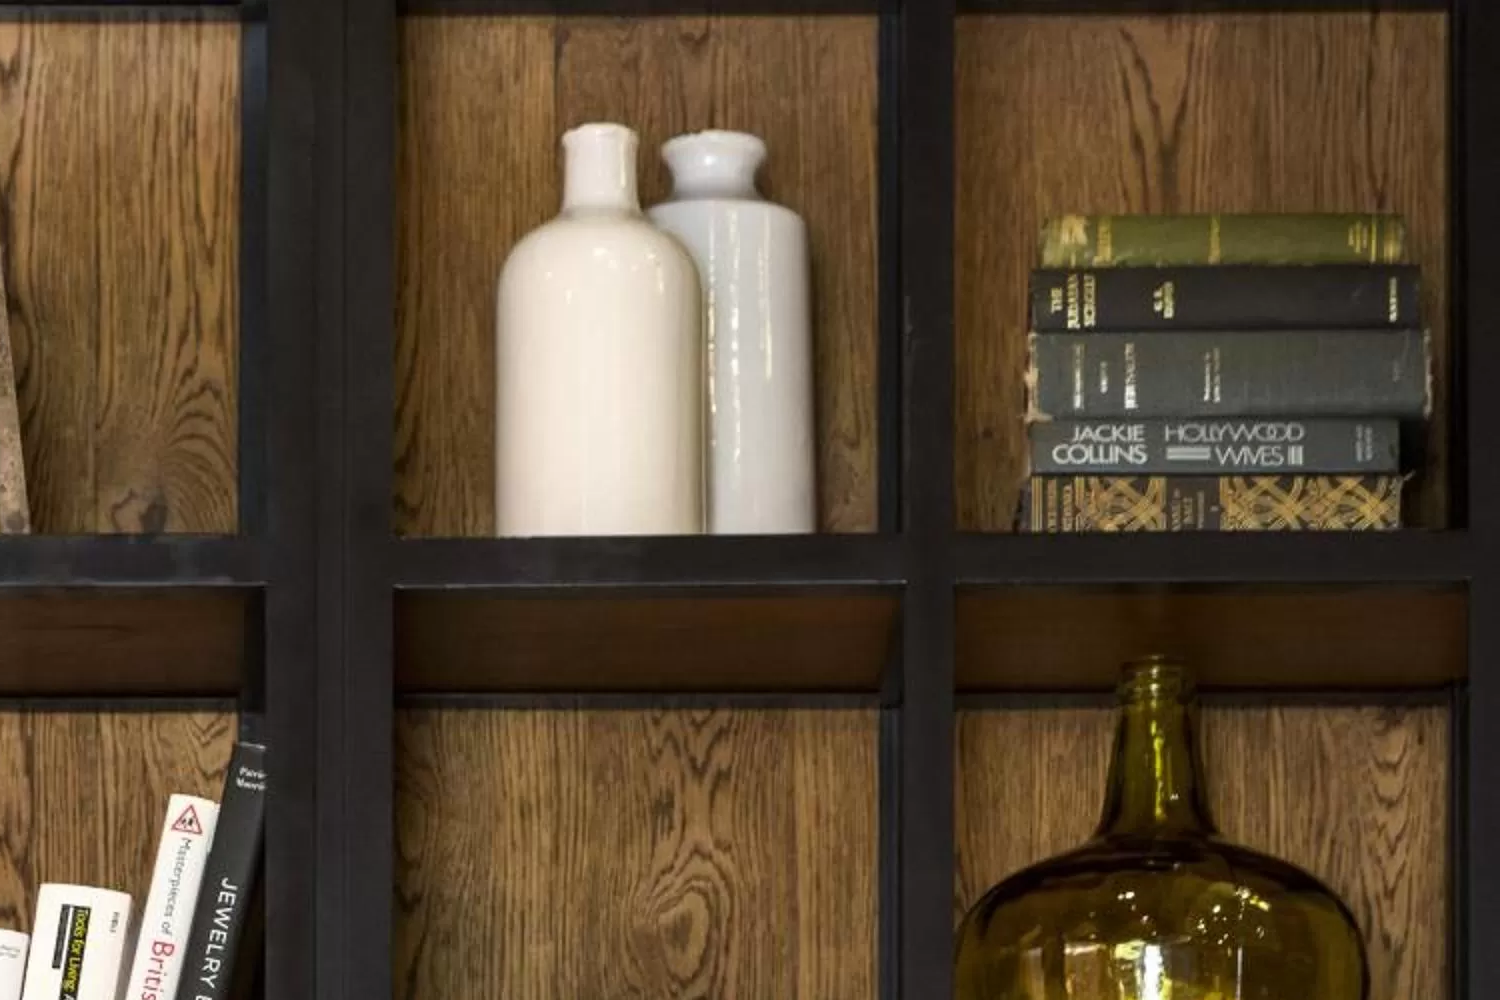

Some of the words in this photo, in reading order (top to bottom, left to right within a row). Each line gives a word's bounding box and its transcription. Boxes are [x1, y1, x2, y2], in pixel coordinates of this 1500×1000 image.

[1071, 424, 1146, 443] JACKIE
[1165, 424, 1304, 443] HOLLYWOOD
[1052, 444, 1148, 465] COLLINS
[1214, 445, 1285, 466] WIVES
[164, 837, 192, 918] Masterpieces
[74, 909, 89, 938] Tools
[161, 921, 172, 936] of
[200, 877, 239, 989] JEWELRY
[71, 939, 85, 954] for
